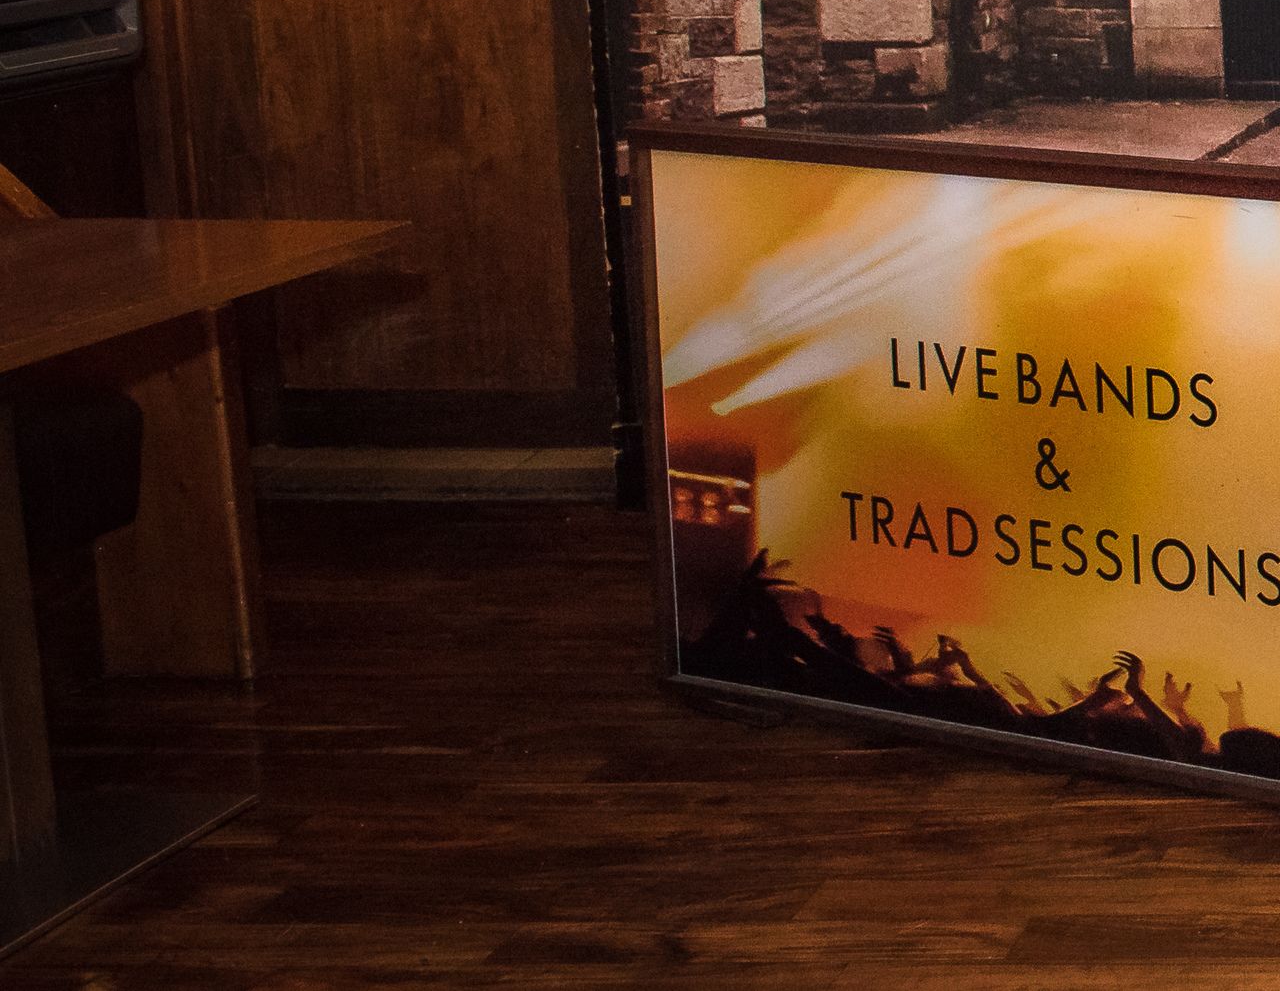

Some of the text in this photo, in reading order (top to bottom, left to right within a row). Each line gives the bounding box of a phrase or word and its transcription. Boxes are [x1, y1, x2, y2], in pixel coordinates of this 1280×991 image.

[891, 337, 1218, 428] LIVE BANDS
[1035, 437, 1071, 492] &
[840, 491, 979, 558] TRAD
